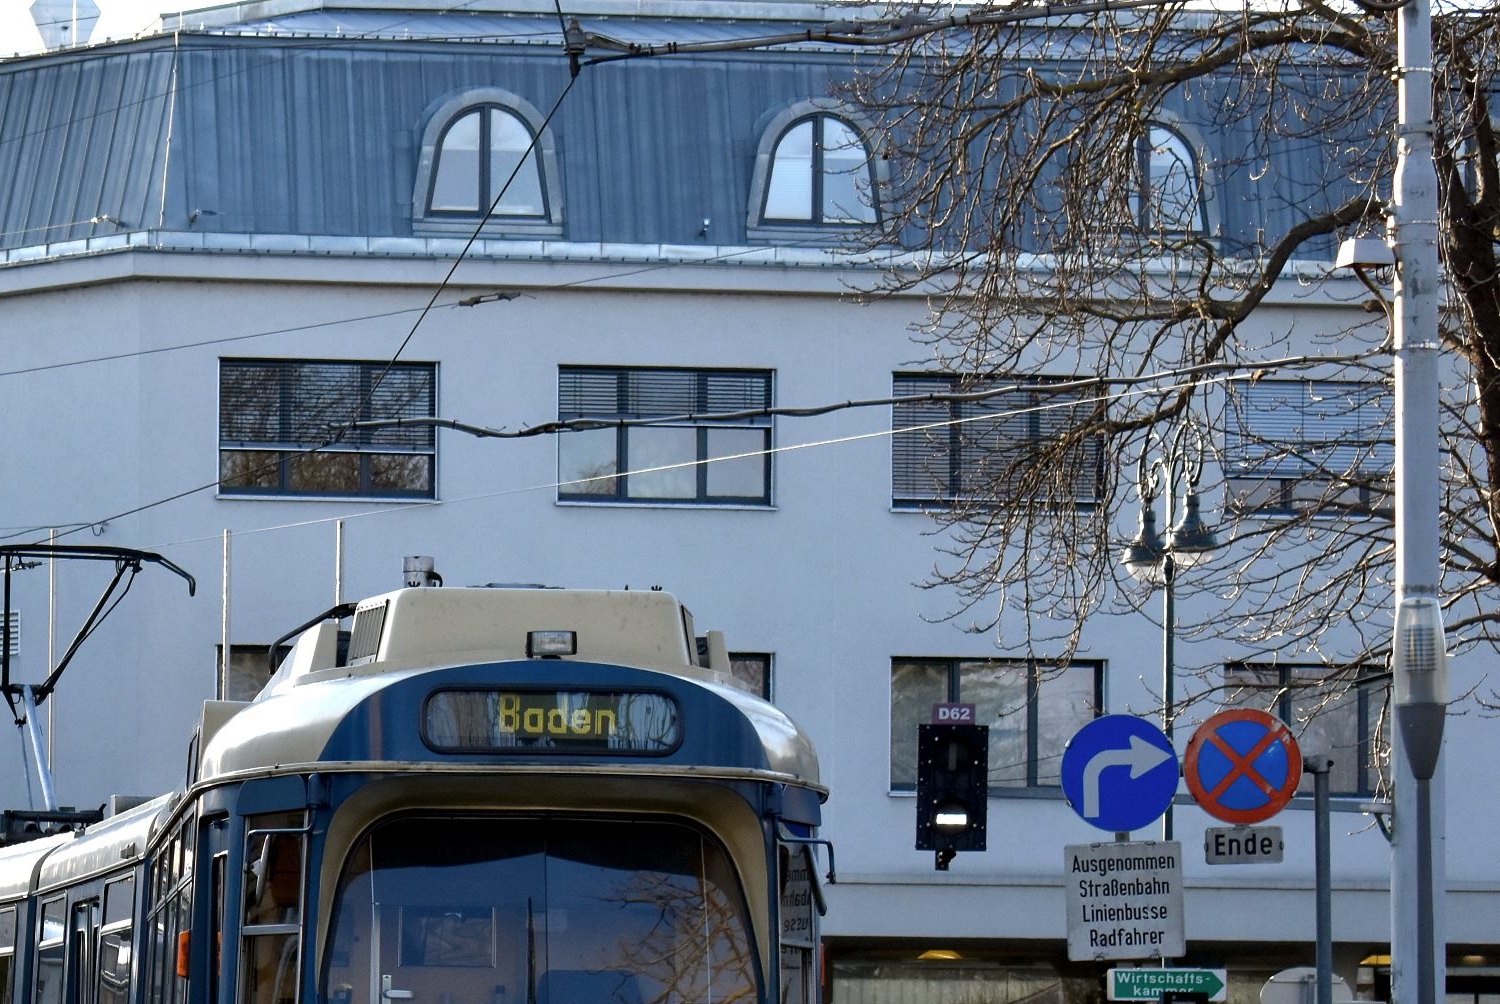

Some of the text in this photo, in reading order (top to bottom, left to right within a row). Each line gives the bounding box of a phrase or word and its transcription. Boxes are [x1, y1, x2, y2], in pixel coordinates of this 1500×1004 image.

[499, 693, 616, 735] Baden
[938, 707, 970, 720] D62
[1214, 833, 1273, 856] Ende
[1072, 855, 1175, 876] Ausgenommen
[1079, 877, 1170, 897] Straßenbahn
[1082, 903, 1168, 922] Linienbusse
[1090, 928, 1165, 947] Radfahrer
[1116, 972, 1211, 984] Wirtschafts-
